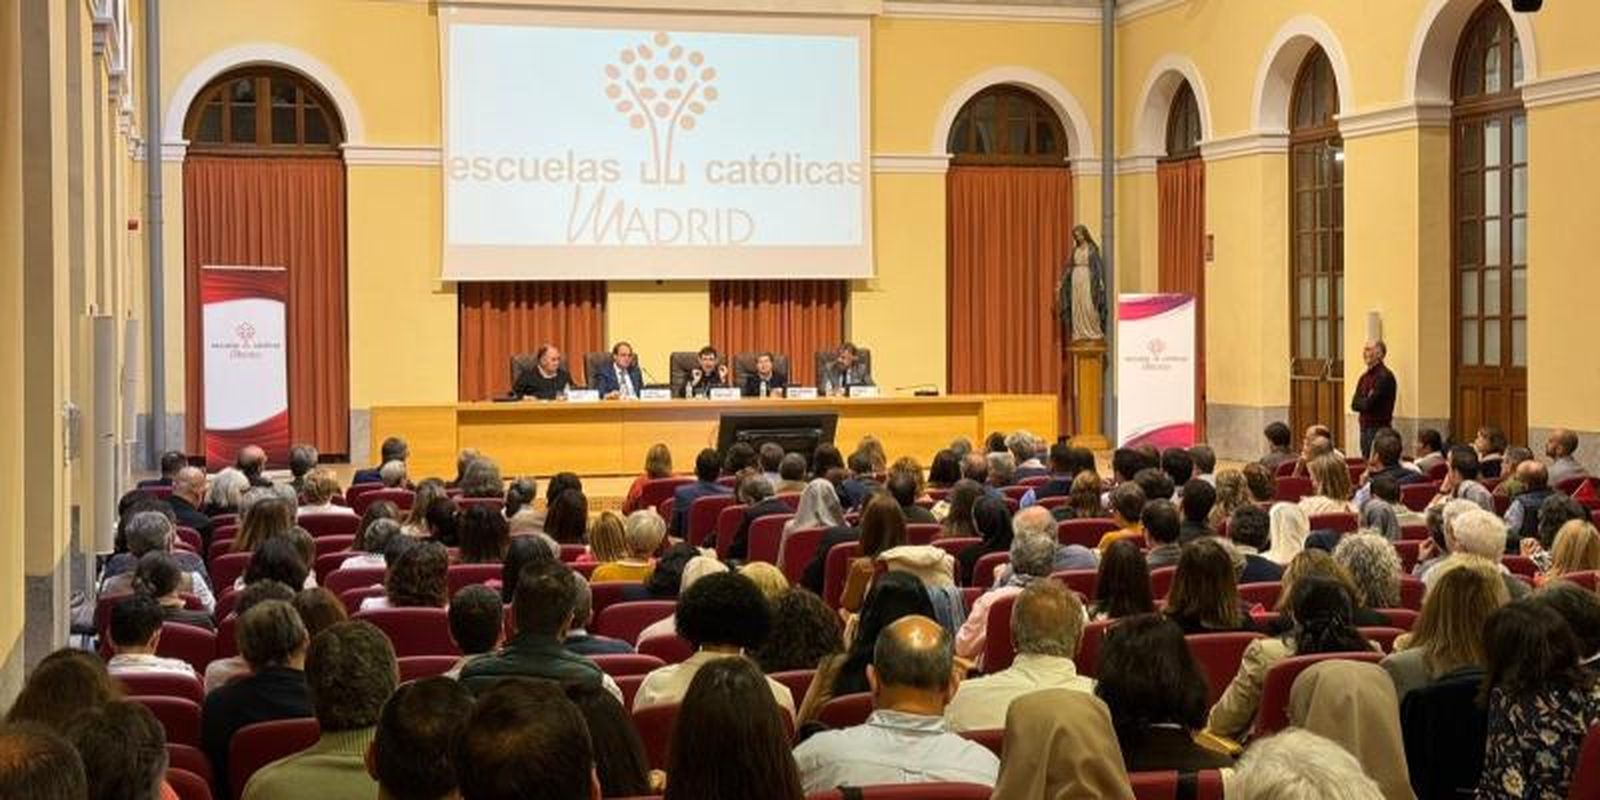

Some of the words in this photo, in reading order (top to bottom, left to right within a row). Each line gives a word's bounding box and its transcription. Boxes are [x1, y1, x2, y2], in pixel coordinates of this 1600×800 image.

[449, 149, 621, 183] escuelas
[705, 152, 863, 185] católicas
[567, 184, 754, 243] MADRID
